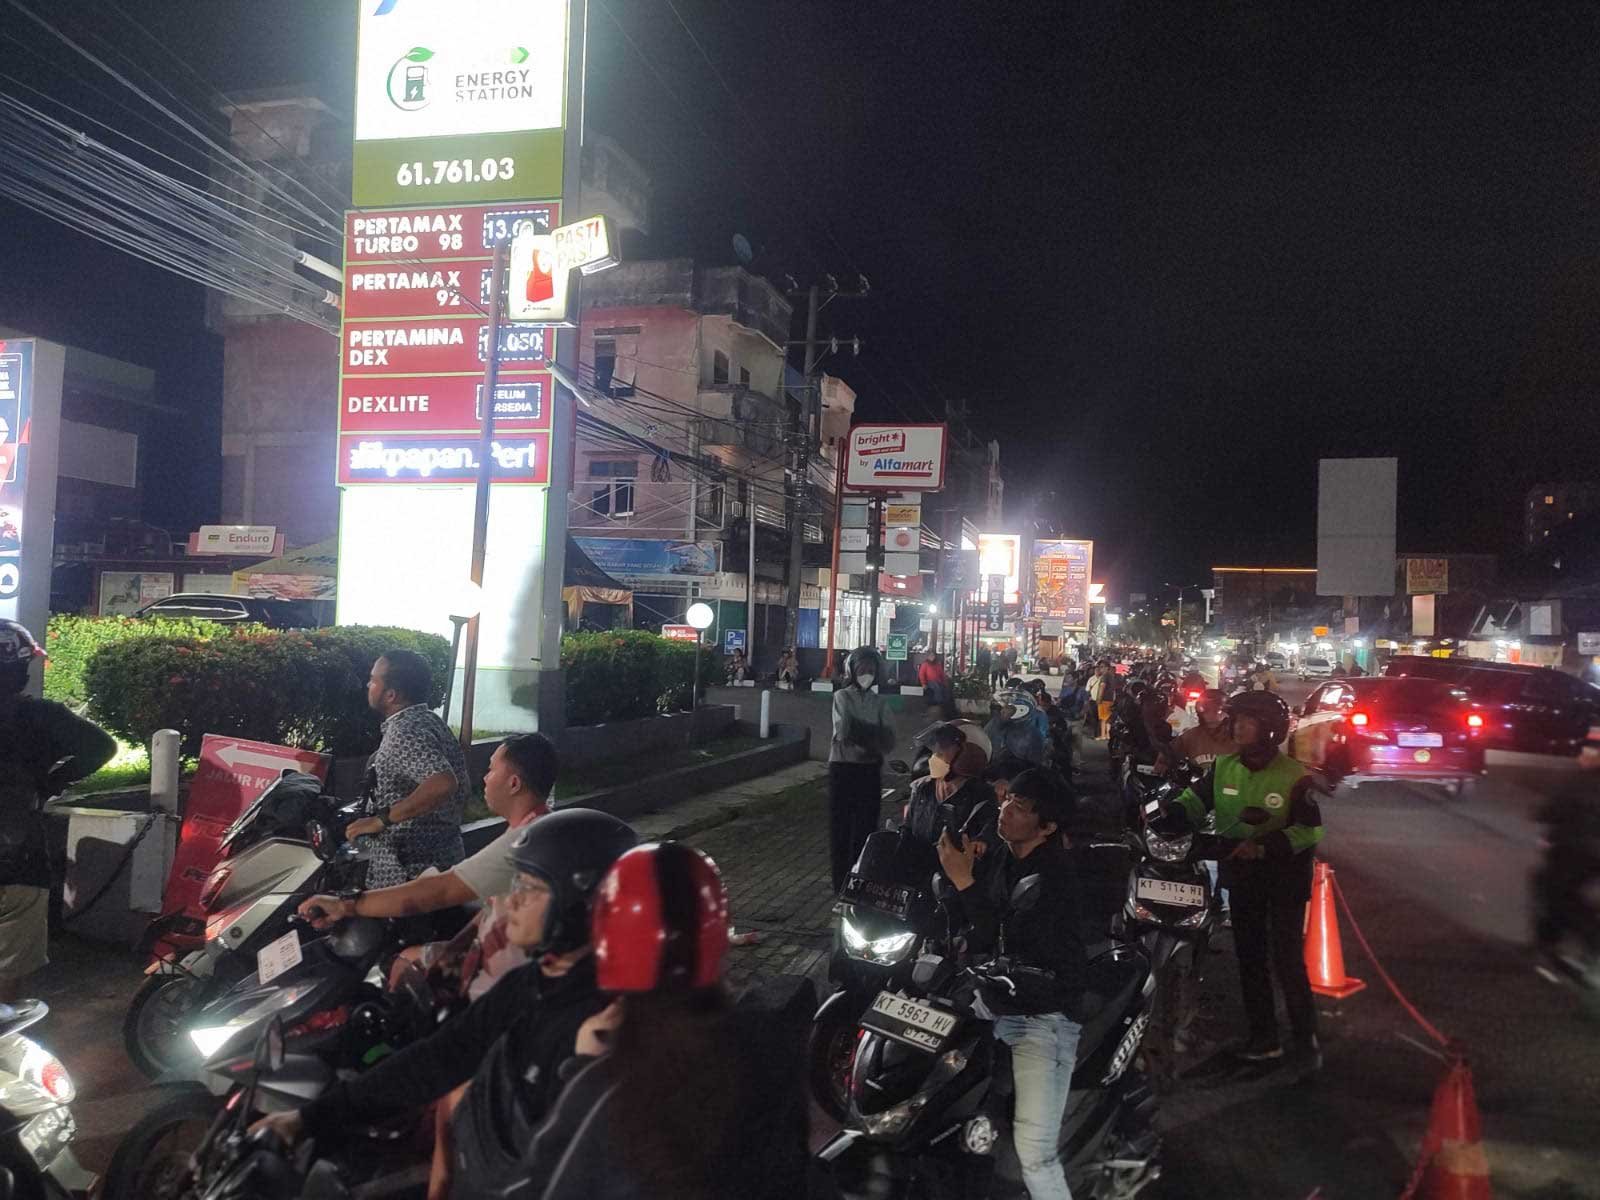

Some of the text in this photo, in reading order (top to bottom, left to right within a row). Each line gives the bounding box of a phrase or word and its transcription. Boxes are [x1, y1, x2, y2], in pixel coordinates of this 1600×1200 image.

[455, 69, 530, 88] ENERGY
[455, 85, 534, 103] STATION
[396, 157, 516, 186] 61.761.03
[353, 214, 463, 236] PERTAMAX
[354, 233, 464, 254] TURBO 98
[351, 270, 461, 291] PERTAMAX
[436, 289, 460, 306] 92
[349, 327, 464, 348] PERTAMINA
[349, 348, 389, 366] DEX
[348, 395, 430, 413] DEXLITE
[493, 402, 533, 413] RSEDIA
[858, 432, 891, 446] bright
[859, 458, 934, 471] by Alfamart
[228, 533, 270, 543] Enduro
[727, 631, 736, 642] P
[1140, 879, 1153, 889] KT
[1161, 883, 1185, 894] 5114
[875, 995, 952, 1032] KT 5963 HV
